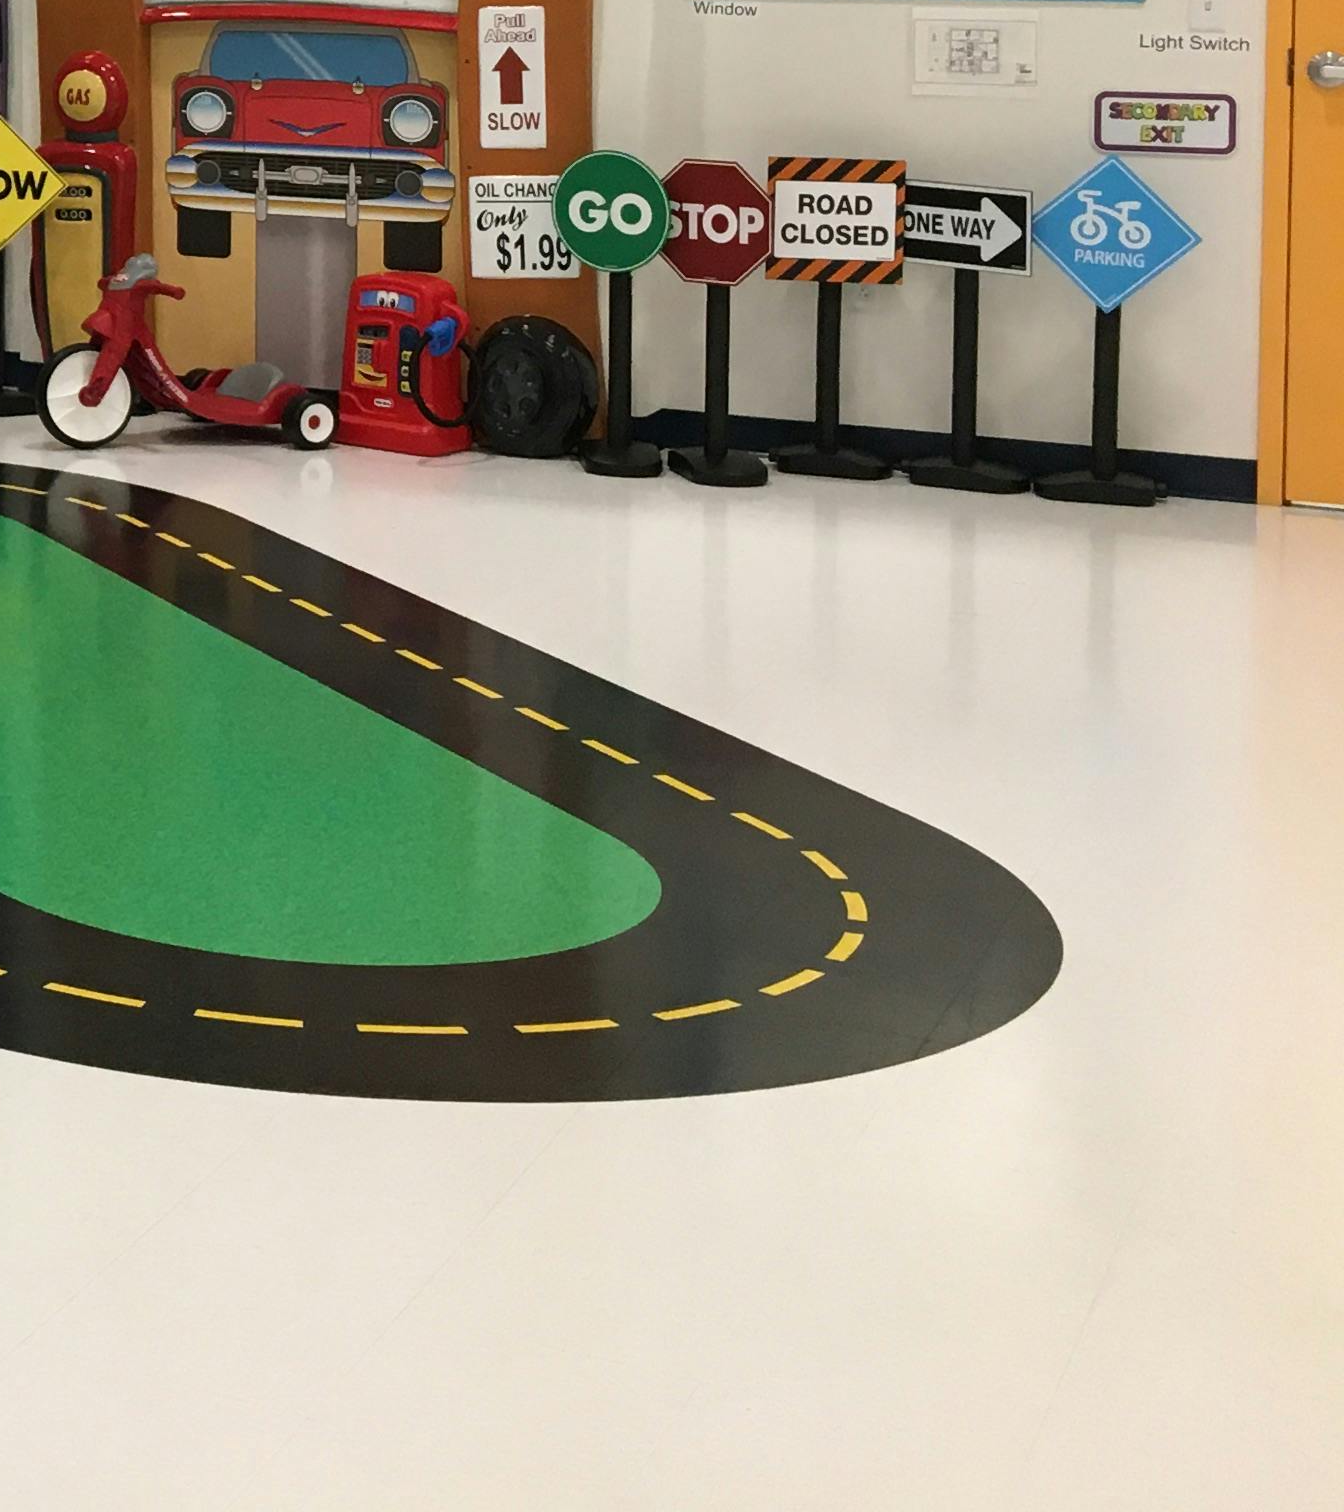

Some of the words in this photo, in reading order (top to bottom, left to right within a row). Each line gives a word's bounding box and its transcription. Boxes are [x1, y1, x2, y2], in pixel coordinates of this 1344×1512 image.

[693, 0, 758, 17] Window
[494, 13, 526, 28] Pull
[484, 28, 537, 43] Ahead
[1139, 34, 1184, 52] Light
[1189, 35, 1251, 52] Switch
[66, 88, 91, 106] GAS
[487, 112, 541, 131] SLOW
[1108, 101, 1221, 122] SECONDARY
[1139, 124, 1185, 144] EXIT
[475, 183, 500, 198] OIL
[504, 183, 556, 198] CHAN
[568, 190, 653, 236] GO
[797, 193, 873, 216] ROAD
[477, 205, 529, 231] Only
[667, 200, 765, 245] STOP
[904, 210, 944, 236] ONE
[950, 214, 996, 240] WAY
[780, 222, 889, 247] CLOSED
[496, 232, 572, 274] $1.99
[1074, 248, 1145, 268] PARKING
